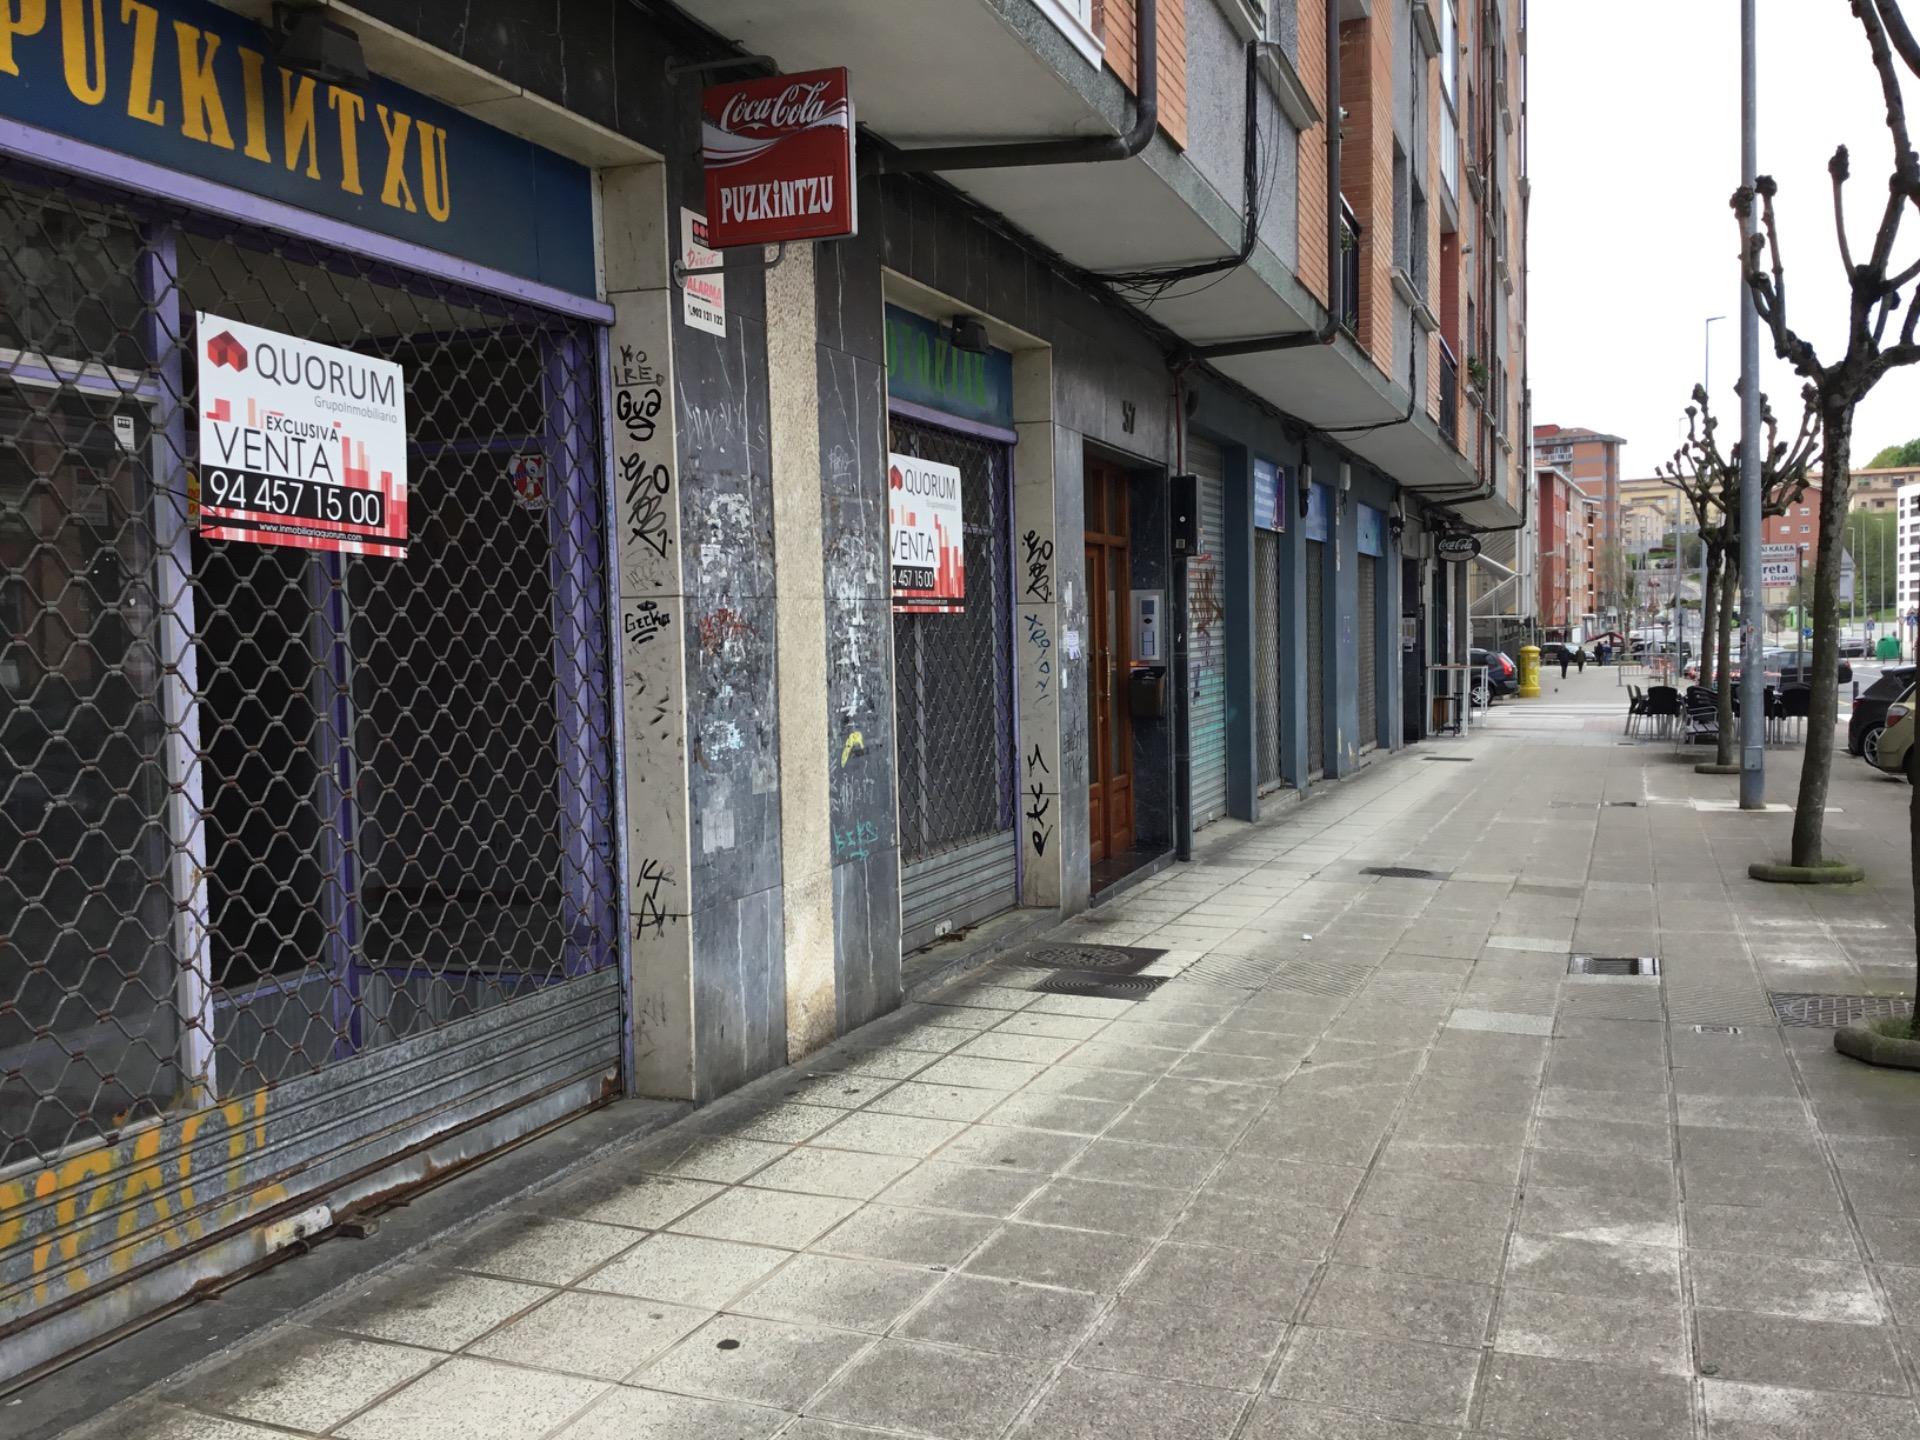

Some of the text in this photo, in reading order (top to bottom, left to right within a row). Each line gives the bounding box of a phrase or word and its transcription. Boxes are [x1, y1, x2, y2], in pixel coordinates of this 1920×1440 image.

[255, 343, 395, 407] QUORUM
[214, 422, 335, 482] VENTA
[266, 415, 340, 443] EXCLUSIVA
[210, 470, 247, 509] 94
[254, 478, 304, 515] 457
[313, 486, 343, 521] 15
[349, 491, 380, 526] 00
[905, 469, 956, 500] QUORUM
